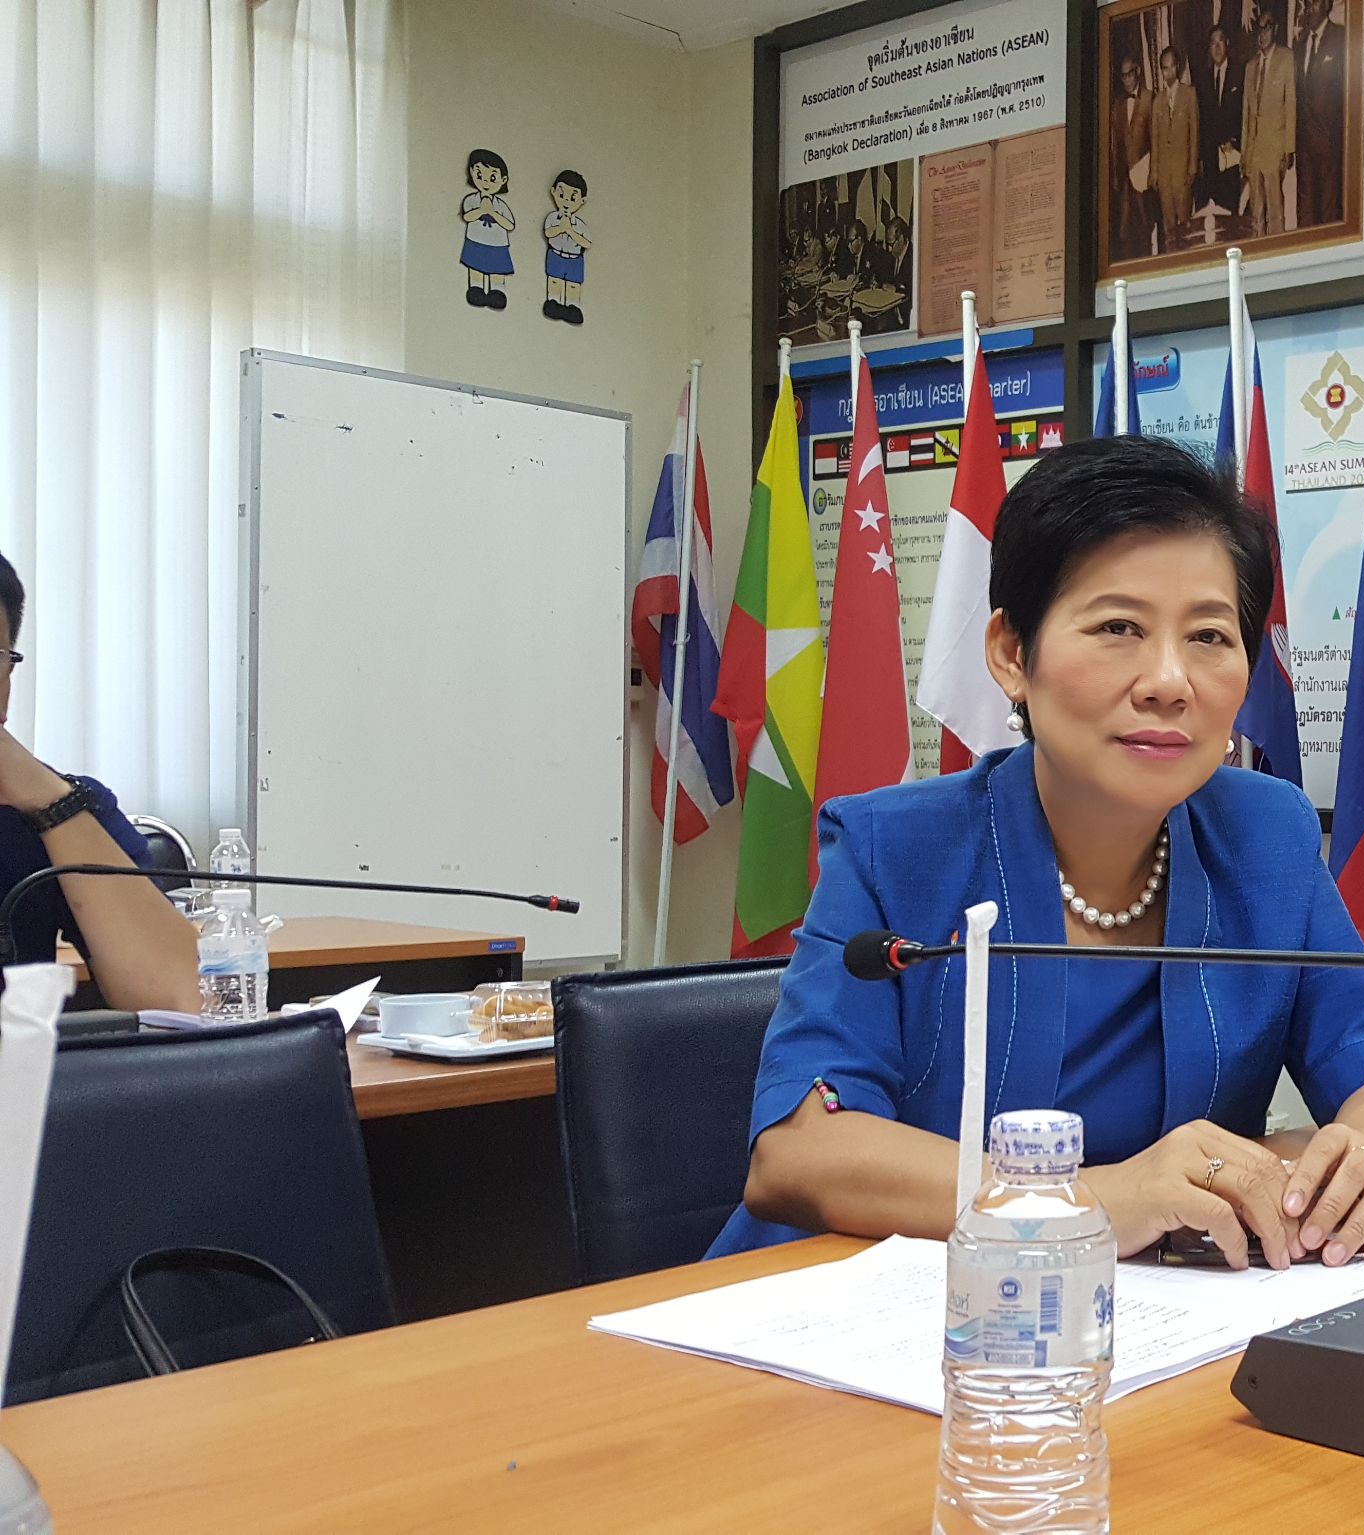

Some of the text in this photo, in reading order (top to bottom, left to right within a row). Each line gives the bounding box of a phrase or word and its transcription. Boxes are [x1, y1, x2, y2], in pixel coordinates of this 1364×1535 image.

[867, 24, 975, 72] จุดเริ่มต้นของอาเซียน
[801, 28, 1050, 107] Association of Southeast Asian Nations (ASEAN)
[803, 142, 849, 165] (Bangkok
[851, 126, 913, 151] Declaration)
[916, 121, 931, 137] เมื่อ
[932, 121, 938, 132] 8
[940, 113, 970, 131] สิงหาคม
[972, 108, 994, 124] 1967
[1018, 94, 1046, 114] 2510)
[928, 382, 964, 410] (ASEA
[1178, 415, 1190, 432] คือ
[1300, 461, 1337, 475] ASEAN
[1292, 475, 1347, 490] THAILAND
